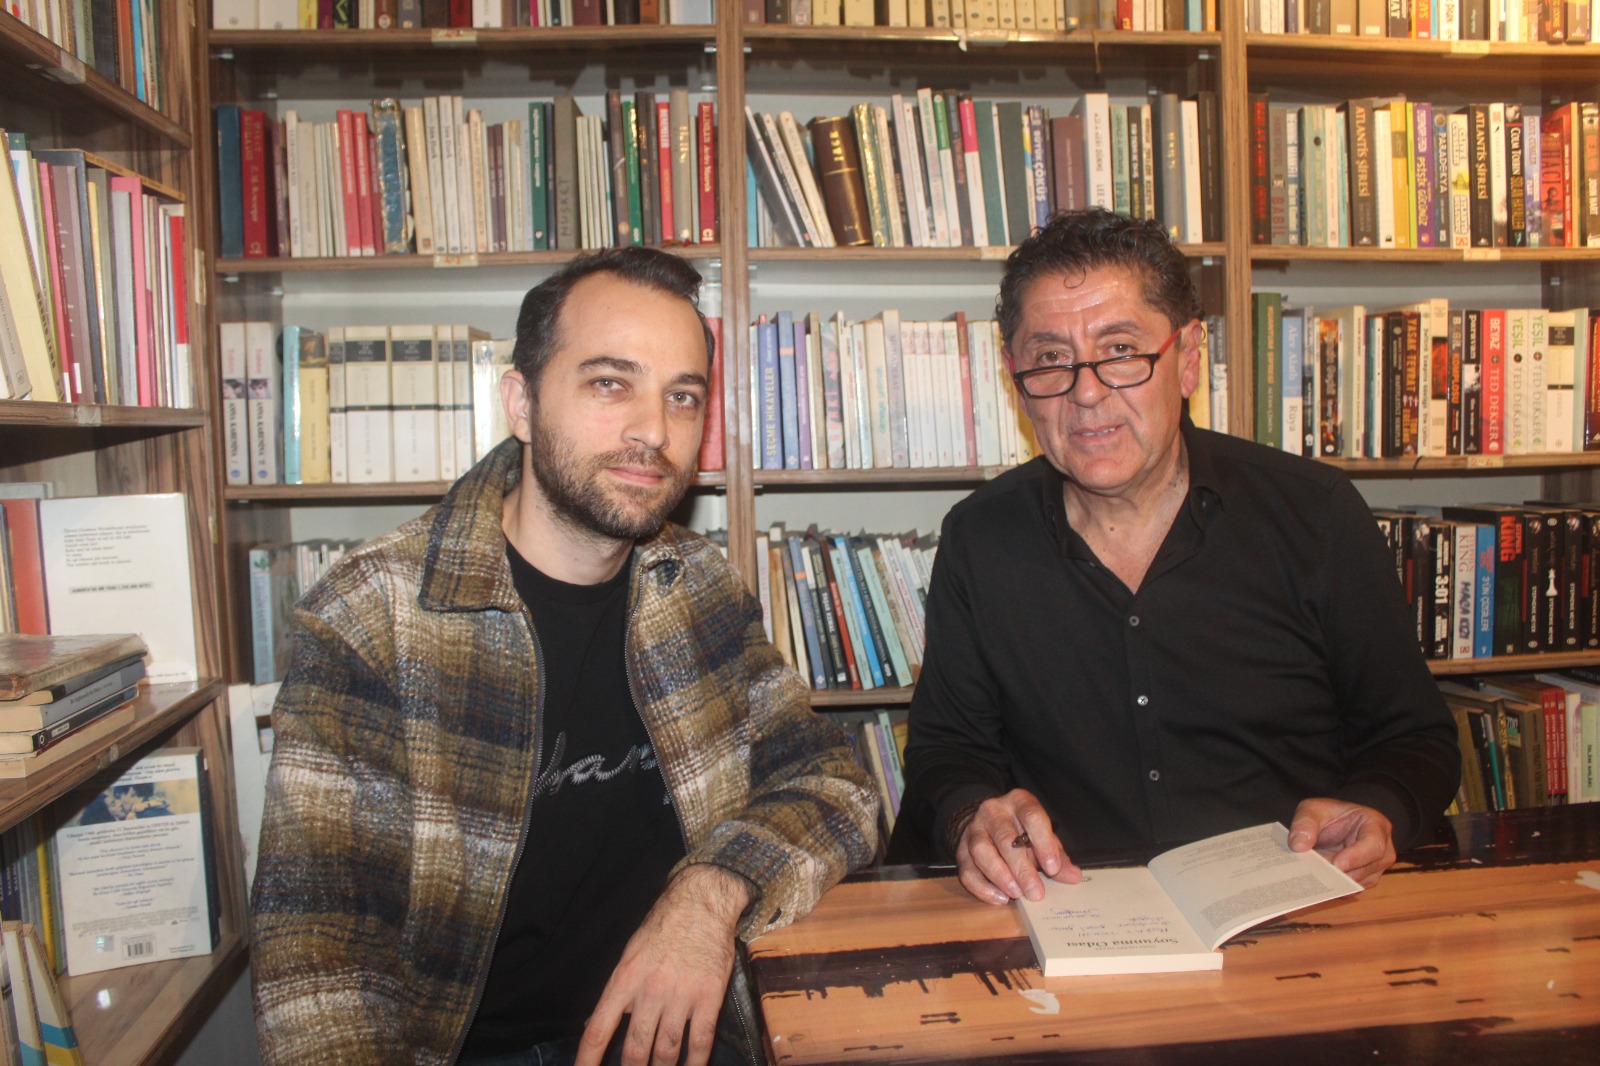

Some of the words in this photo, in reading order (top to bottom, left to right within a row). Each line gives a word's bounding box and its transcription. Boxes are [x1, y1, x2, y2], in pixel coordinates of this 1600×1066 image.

[1356, 106, 1369, 158] ATLANTİS
[1476, 111, 1488, 161] ATLANTİS
[1510, 127, 1521, 149] COLM
[1033, 162, 1046, 201] ÇÖKÜŞ
[1356, 160, 1370, 196] ŞİFRESİ
[1415, 157, 1428, 187] PSİŞİK
[1475, 162, 1488, 200] ŞİFRESİ
[1588, 178, 1597, 196] JOHN
[1096, 184, 1105, 196] LEE
[1589, 197, 1598, 215] HART
[1271, 196, 1287, 238] BABİL
[1418, 189, 1428, 227] GÜCÜNÜZ
[1288, 325, 1298, 349] Alev
[1407, 318, 1418, 351] YASAK
[1469, 314, 1478, 360] paravan
[1489, 317, 1500, 349] BEYAZ
[1511, 317, 1523, 349] YEŞİL
[1531, 315, 1544, 348] YEŞİL
[1288, 352, 1299, 381] Alatlı
[1406, 353, 1417, 392] TEVRAT
[1451, 352, 1460, 404] KOMPLOSU
[1489, 368, 1499, 392] TED
[1512, 367, 1522, 390] TED
[1532, 365, 1542, 387] TED
[765, 367, 776, 421] HİKAYELER
[1287, 405, 1299, 432] Rüya
[1489, 395, 1499, 441] DEKKER
[1513, 393, 1522, 438] DEKKER
[1532, 392, 1542, 437] DEKKER
[230, 422, 238, 457] KARENİNA
[257, 421, 265, 456] KARENİNA
[765, 423, 778, 456] SEÇME
[1458, 534, 1469, 572] KING
[1500, 516, 1516, 562] KING
[1435, 575, 1449, 604] 3:01
[821, 592, 830, 611] YAŞAR
[826, 612, 835, 633] KEMAL
[1112, 937, 1178, 946] Soyunma
